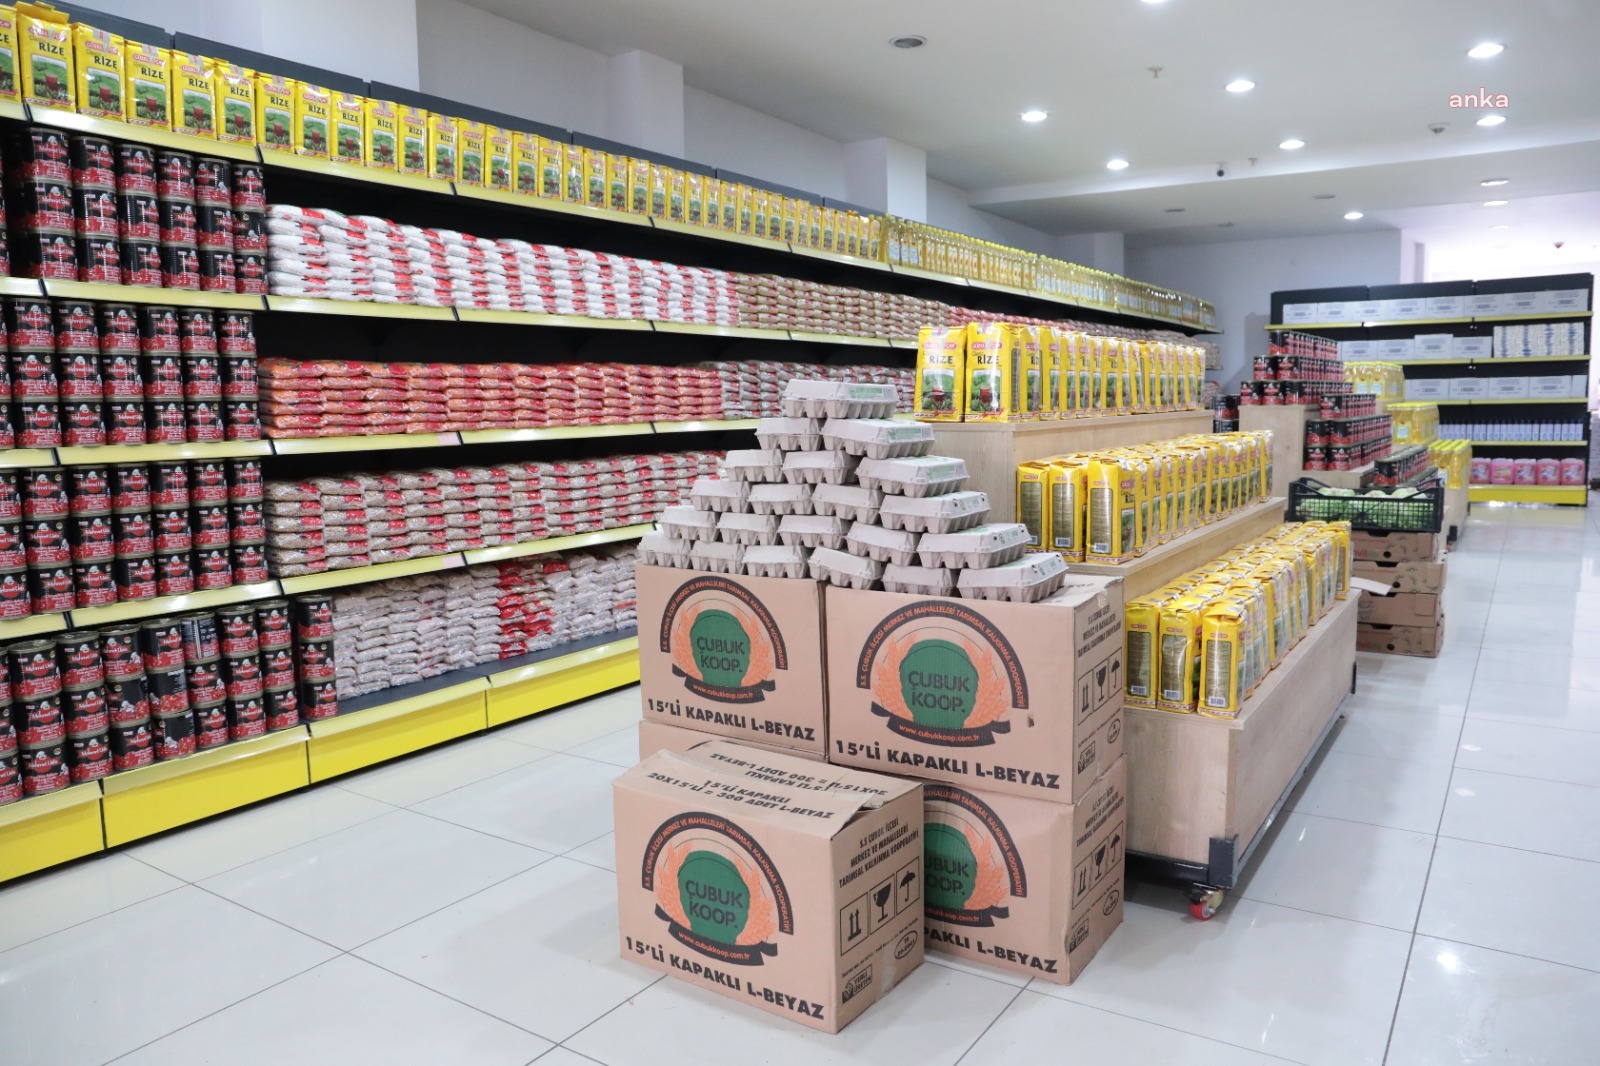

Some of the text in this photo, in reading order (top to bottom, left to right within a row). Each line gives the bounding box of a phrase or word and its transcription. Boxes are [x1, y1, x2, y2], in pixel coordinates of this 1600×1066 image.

[38, 42, 65, 56] RİZE
[94, 55, 118, 69] RİZE
[141, 67, 164, 80] RİZE
[188, 78, 209, 90] RİZE
[230, 86, 250, 98] RİZE
[270, 96, 289, 108] RİZE
[929, 354, 953, 365] RİZE
[696, 636, 746, 656] ÇUBUK
[700, 655, 743, 673] KOOP.
[956, 609, 986, 631] TARIMSAL
[985, 627, 1012, 661] KALKINMA
[1008, 660, 1026, 708] KOOPERATİFİ
[908, 670, 970, 693] ÇUBUK
[911, 691, 966, 713] KOOP.
[686, 705, 746, 728] KAPAKLI
[751, 718, 815, 741] L-BEYAZ
[900, 724, 980, 742] www.cubukkoop.com.tr
[710, 753, 754, 769] L-BEYAZ
[756, 765, 788, 777] ADET
[835, 740, 1060, 790] 15'Lİ KAPAKLI L-BEYAZ
[789, 773, 815, 783] 300
[716, 791, 744, 801] 300
[745, 798, 779, 810] ADET
[779, 805, 835, 819] L-BEYAZ
[737, 788, 792, 804] KAPAKLI
[961, 796, 989, 818] TARIMSAL
[987, 817, 1010, 851] KALKINMA
[924, 856, 969, 878] UBUK
[726, 825, 753, 850] TARIMSAL
[753, 848, 777, 884] KALKINMA
[774, 884, 791, 933] KOOPERATİFİ
[925, 874, 965, 896] OOP.
[685, 880, 743, 908] ÇUBUK
[689, 900, 738, 929] KOOP.
[678, 931, 750, 959] www.cubukkoop.com.tr
[977, 941, 1057, 973] L-BEYAZ
[626, 936, 824, 1020] 15'Lİ KAPAKLI L-BEYAZ
